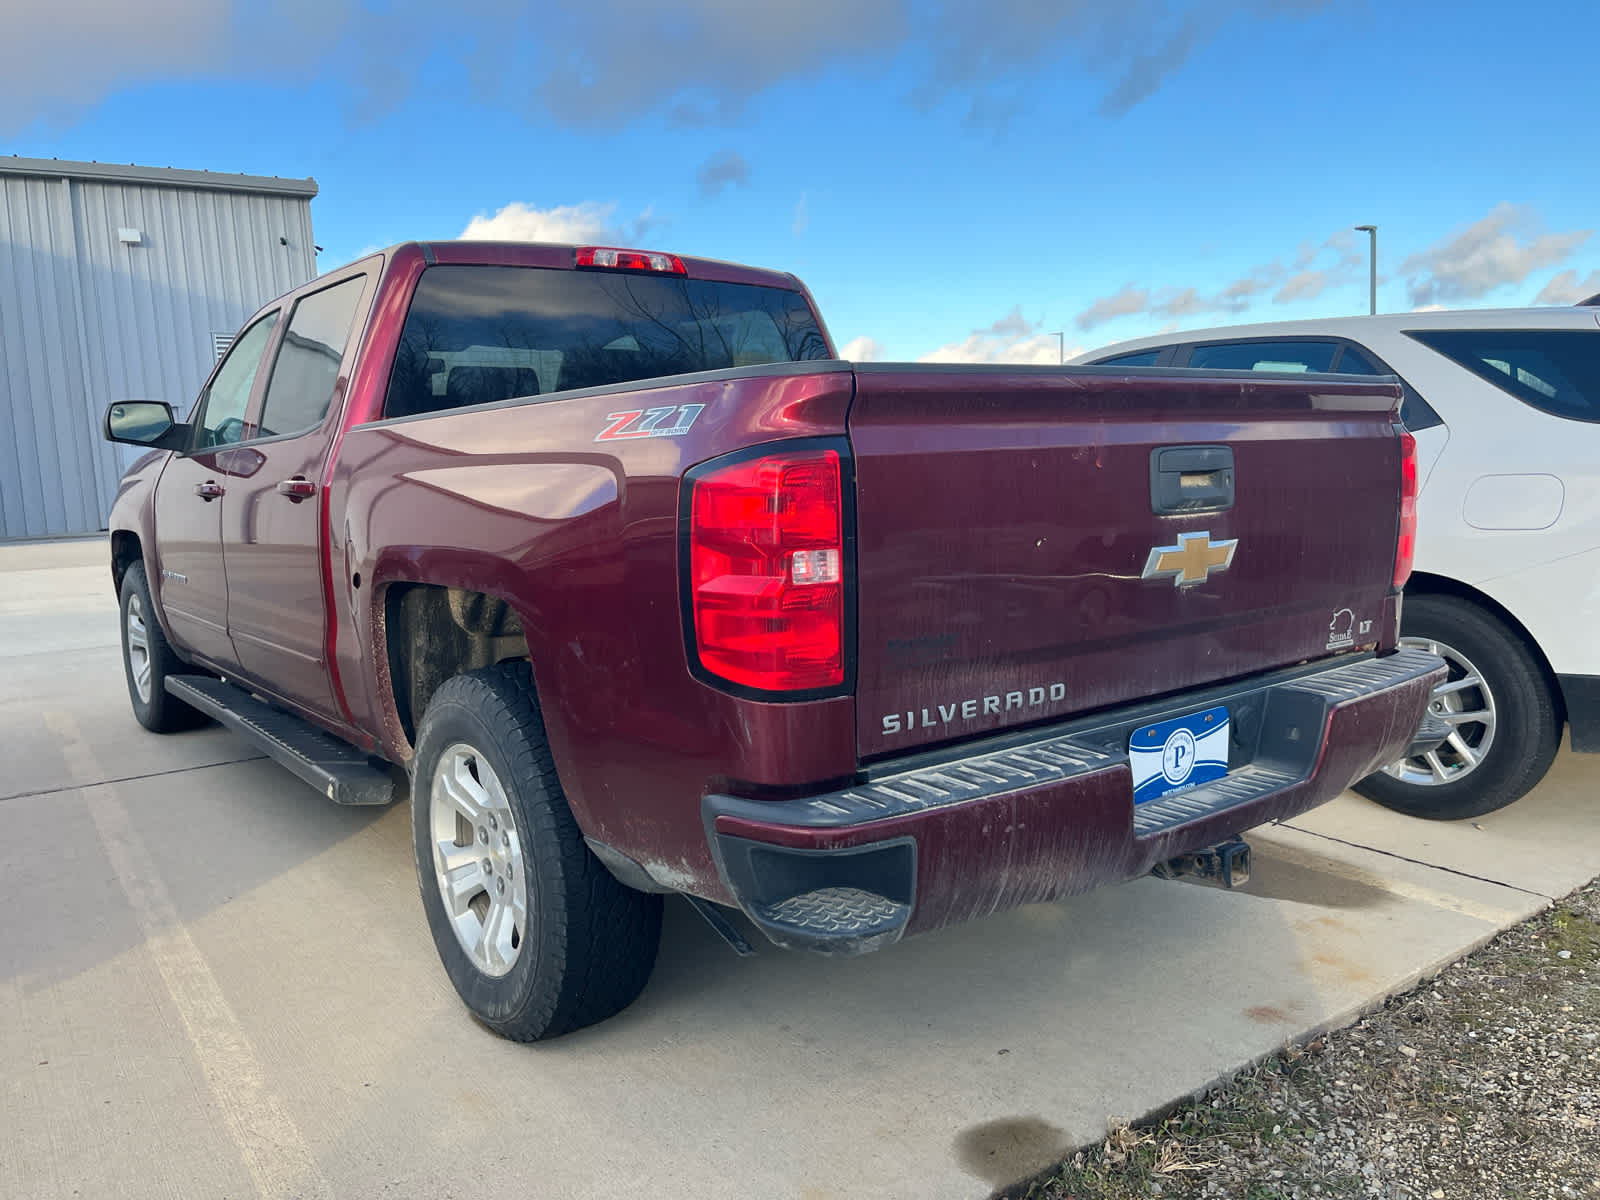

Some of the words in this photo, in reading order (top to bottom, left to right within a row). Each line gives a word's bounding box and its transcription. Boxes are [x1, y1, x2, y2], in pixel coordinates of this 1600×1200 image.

[594, 403, 706, 442] Z71
[1359, 620, 1373, 634] LT
[881, 683, 1066, 736] SILVERADO
[1173, 745, 1186, 769] P
